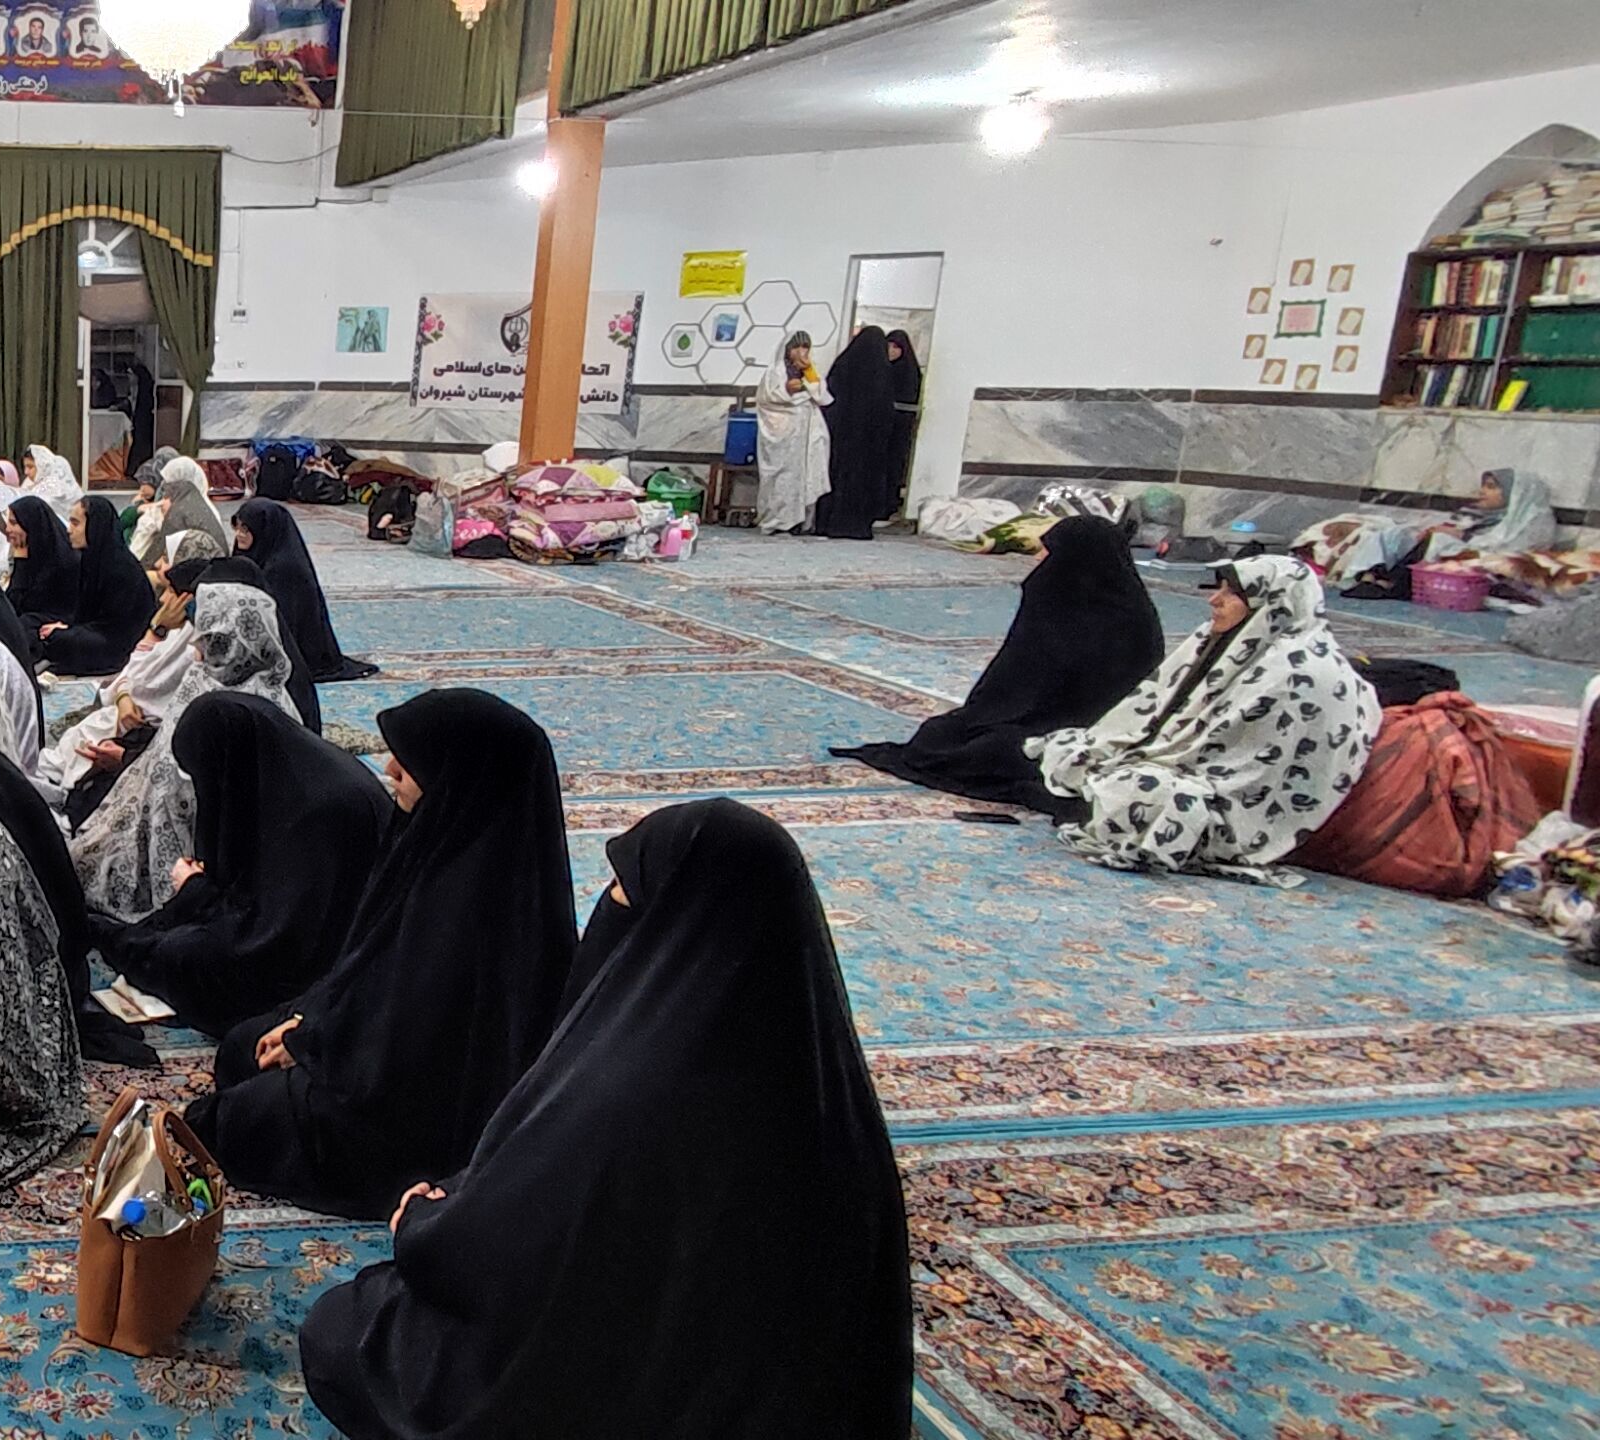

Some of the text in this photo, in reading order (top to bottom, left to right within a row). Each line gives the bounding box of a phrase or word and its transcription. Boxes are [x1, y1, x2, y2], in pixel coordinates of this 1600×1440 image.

[433, 360, 483, 377] اسلامی
[419, 384, 466, 401] شیروان
[580, 388, 619, 404] دانش
